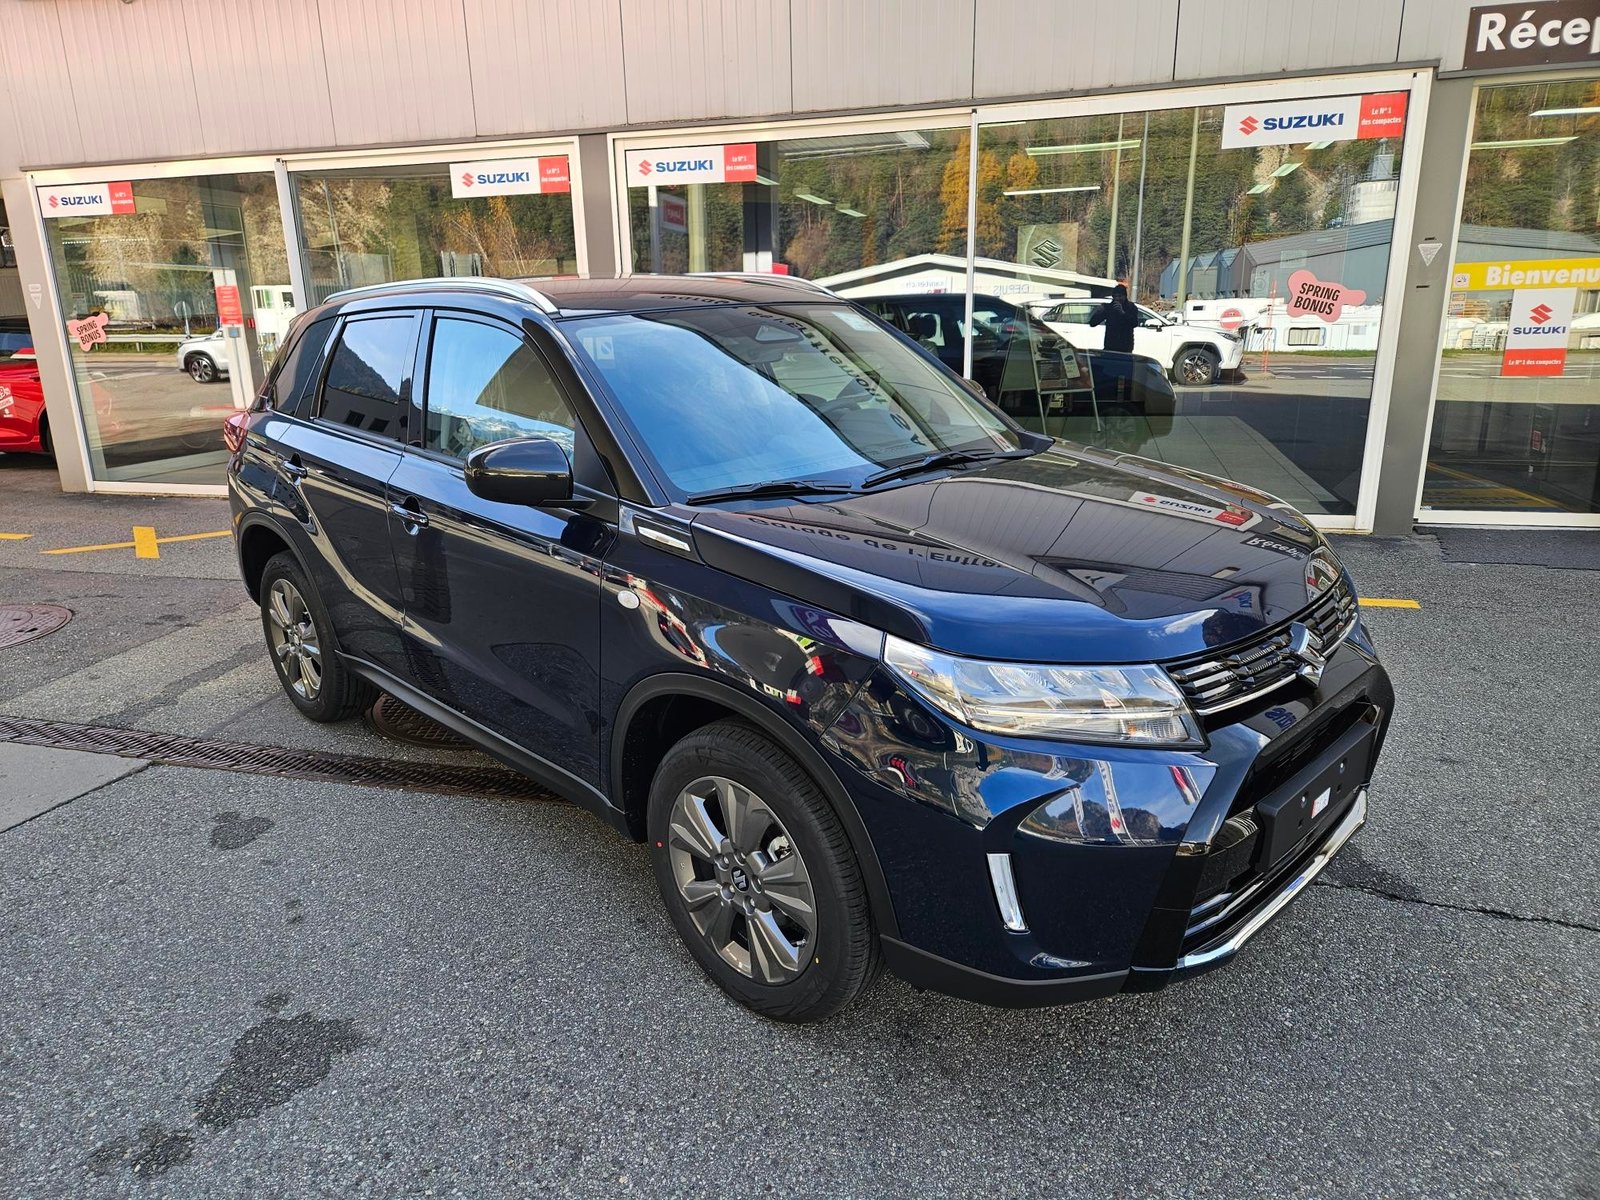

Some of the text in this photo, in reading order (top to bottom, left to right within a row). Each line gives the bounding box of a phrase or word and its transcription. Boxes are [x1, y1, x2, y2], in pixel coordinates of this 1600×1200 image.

[1263, 113, 1344, 131] SUZUKI
[1361, 117, 1402, 126] des compactes
[655, 159, 713, 173] SUZUKI
[477, 172, 530, 185] SUZUKI
[60, 195, 103, 206] SUZUKI
[1299, 282, 1341, 302] SPRING
[1293, 295, 1335, 316] BONUS
[76, 320, 98, 336] SPRING
[1513, 326, 1566, 335] SUZUKI
[80, 329, 101, 345] BONUS
